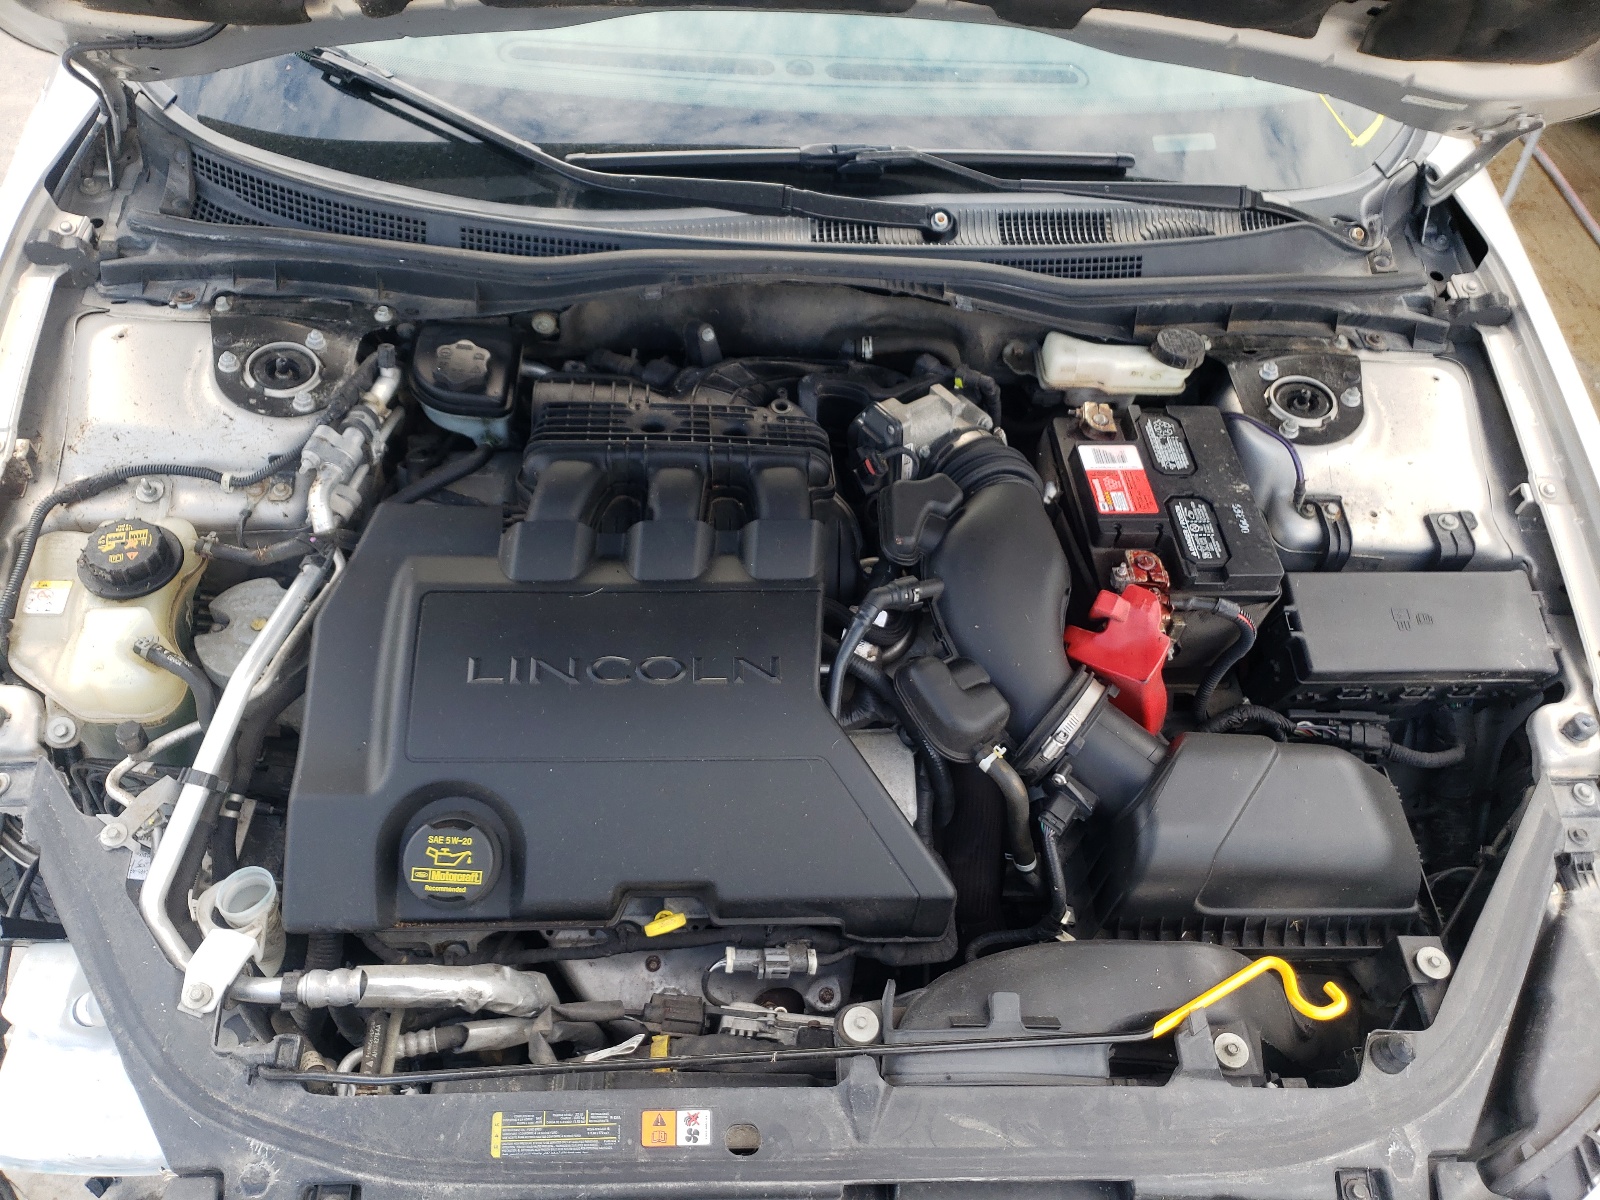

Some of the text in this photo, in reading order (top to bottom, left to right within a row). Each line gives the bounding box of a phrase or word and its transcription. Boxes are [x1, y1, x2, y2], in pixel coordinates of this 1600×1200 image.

[467, 655, 782, 684] LINCOLN
[428, 836, 473, 845] SAE 5W-20
[431, 870, 480, 883] Motorcraft
[425, 884, 467, 893] Recommended
